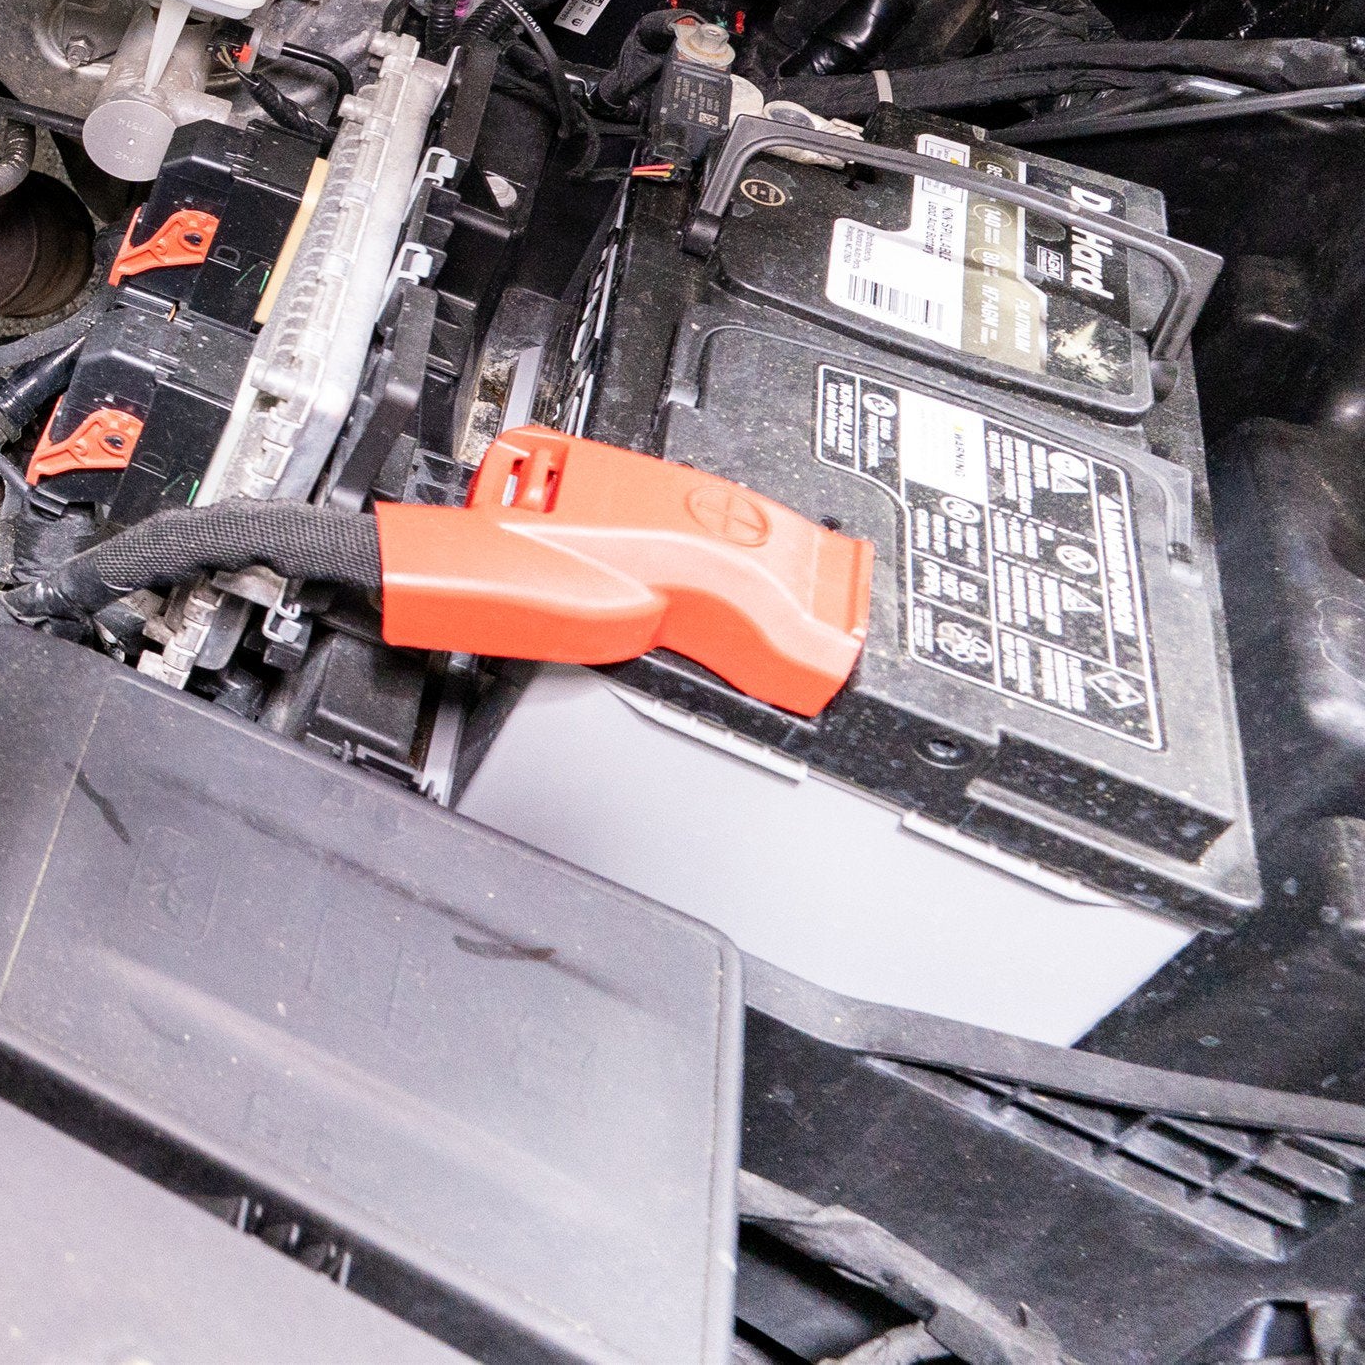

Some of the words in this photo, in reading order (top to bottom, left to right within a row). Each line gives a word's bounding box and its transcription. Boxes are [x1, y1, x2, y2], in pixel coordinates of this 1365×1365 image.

[938, 204, 953, 262] NON-SPILLABLE
[983, 207, 1001, 228] 140
[983, 250, 999, 268] 80
[1045, 251, 1061, 278] AGM
[1070, 185, 1115, 300] DHard
[1012, 296, 1031, 354] PLATINUM
[836, 381, 855, 458] NON-SPILLABLE
[952, 431, 966, 480] WARNING
[940, 570, 958, 601] NOT
[959, 579, 978, 604] DO
[1098, 505, 1136, 638] DANGER/POISON
